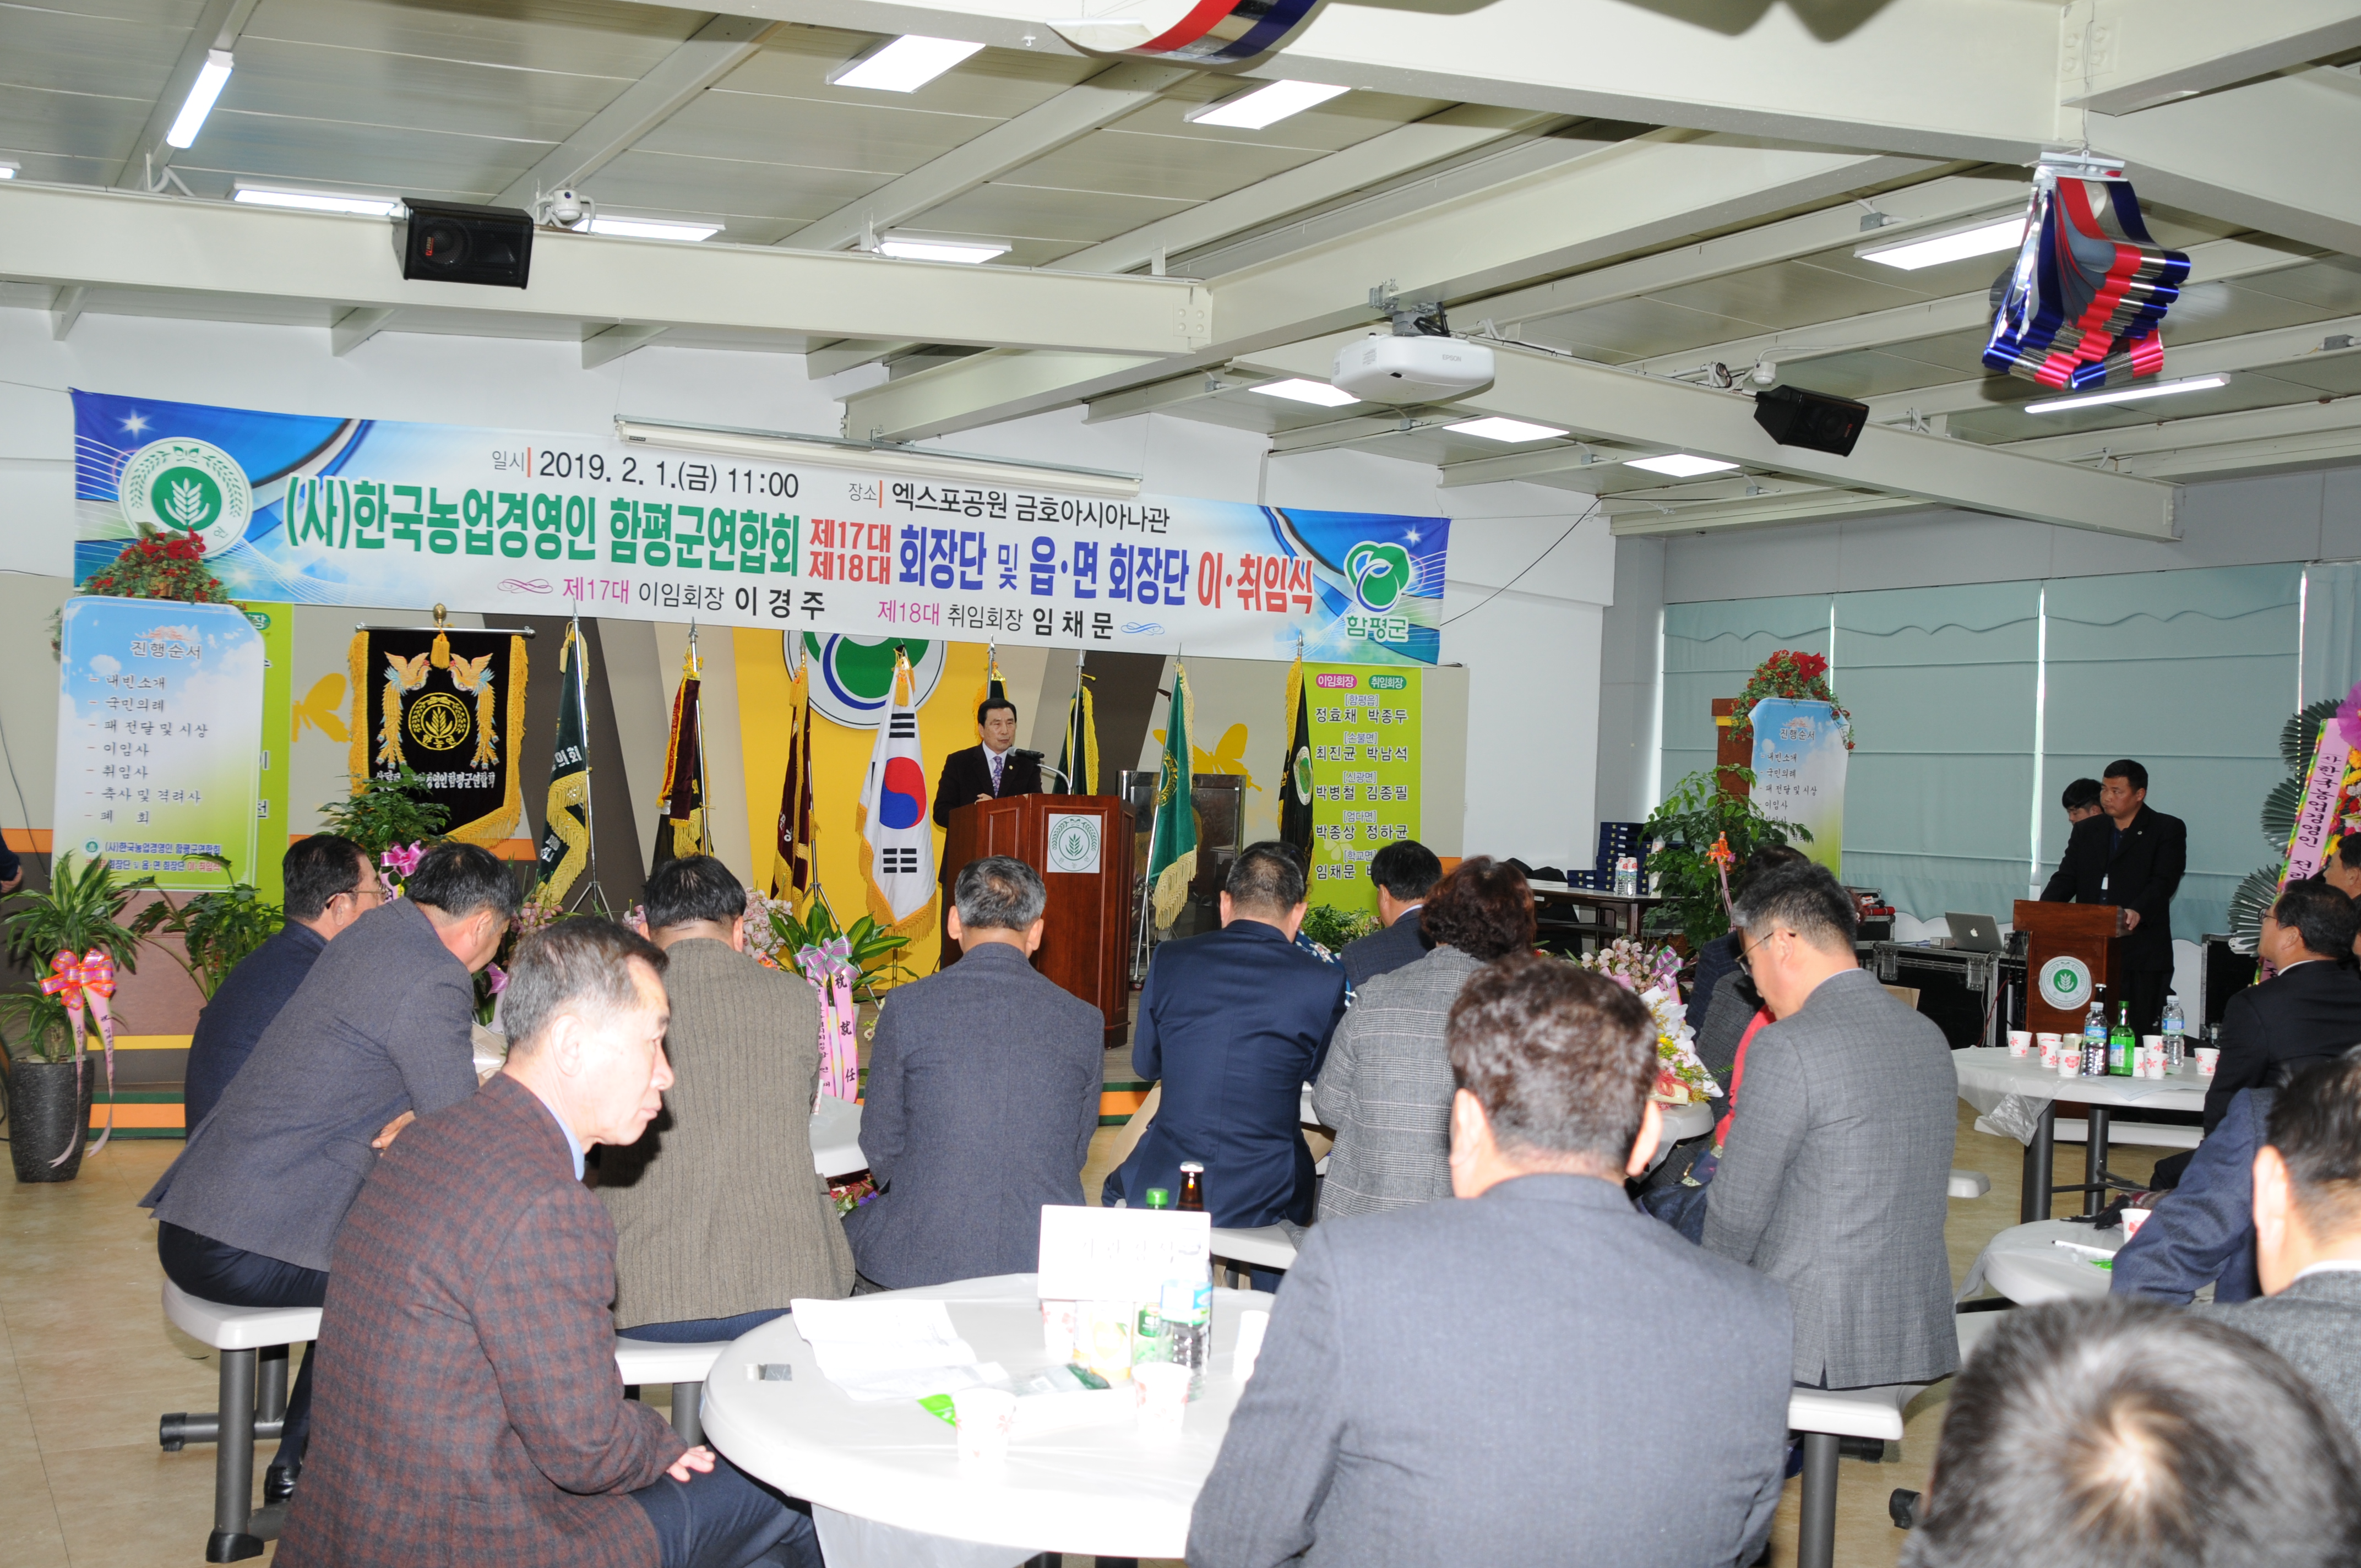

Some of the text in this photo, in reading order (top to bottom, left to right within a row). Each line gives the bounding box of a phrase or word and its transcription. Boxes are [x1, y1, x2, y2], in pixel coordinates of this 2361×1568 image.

[492, 450, 525, 471] 일시
[540, 451, 611, 482] 2019.
[728, 469, 798, 498] 11:00
[848, 482, 877, 502] 장소
[892, 483, 1169, 533] 엑스포공원 금호아시아나관
[286, 474, 800, 577] (사)한국농업경영인 함평군연합회
[810, 518, 891, 553] 제17대
[808, 551, 890, 585] 제18대
[899, 524, 1314, 614] 회장단 및 읍·면 회장단 이·취임식
[563, 576, 629, 604] 제17대
[639, 581, 725, 611] 이임회장
[877, 599, 939, 626] 제18대
[948, 603, 1023, 632] 취임회장
[1347, 617, 1408, 640] 함평군
[132, 641, 200, 660] 진행순서
[106, 675, 165, 691] 내빈소개
[1318, 676, 1403, 689] 이임회장 취임회장
[105, 697, 165, 712] 국민의례
[1346, 694, 1378, 706] [함평읍]
[1316, 708, 1407, 724] 정효채 박종두
[104, 719, 208, 738] 패 전달 및 시상
[1780, 728, 1815, 740] 진행순서
[1345, 732, 1377, 744] [손불면]
[104, 742, 150, 758] 이임사
[1316, 746, 1407, 761] 최진균 박남석
[1767, 753, 1797, 763] 내빈소개
[102, 764, 149, 780] 취임사
[1343, 772, 1376, 783] [신광면]
[1767, 768, 1796, 778] 국민의례
[101, 788, 201, 804] 축사 및 격려사
[1316, 786, 1407, 801] 박병철 김종필
[1776, 785, 1790, 794] 전달
[1794, 785, 1799, 795] 및
[1803, 787, 1817, 796] 시상
[1765, 800, 1788, 810] 이임사
[1343, 811, 1376, 823] [엄다면]
[1316, 825, 1408, 840] 박종상 정하균
[176, 844, 220, 854] 함평군연합회
[163, 861, 184, 871] 회장단
[1316, 865, 1354, 879] 임채문
